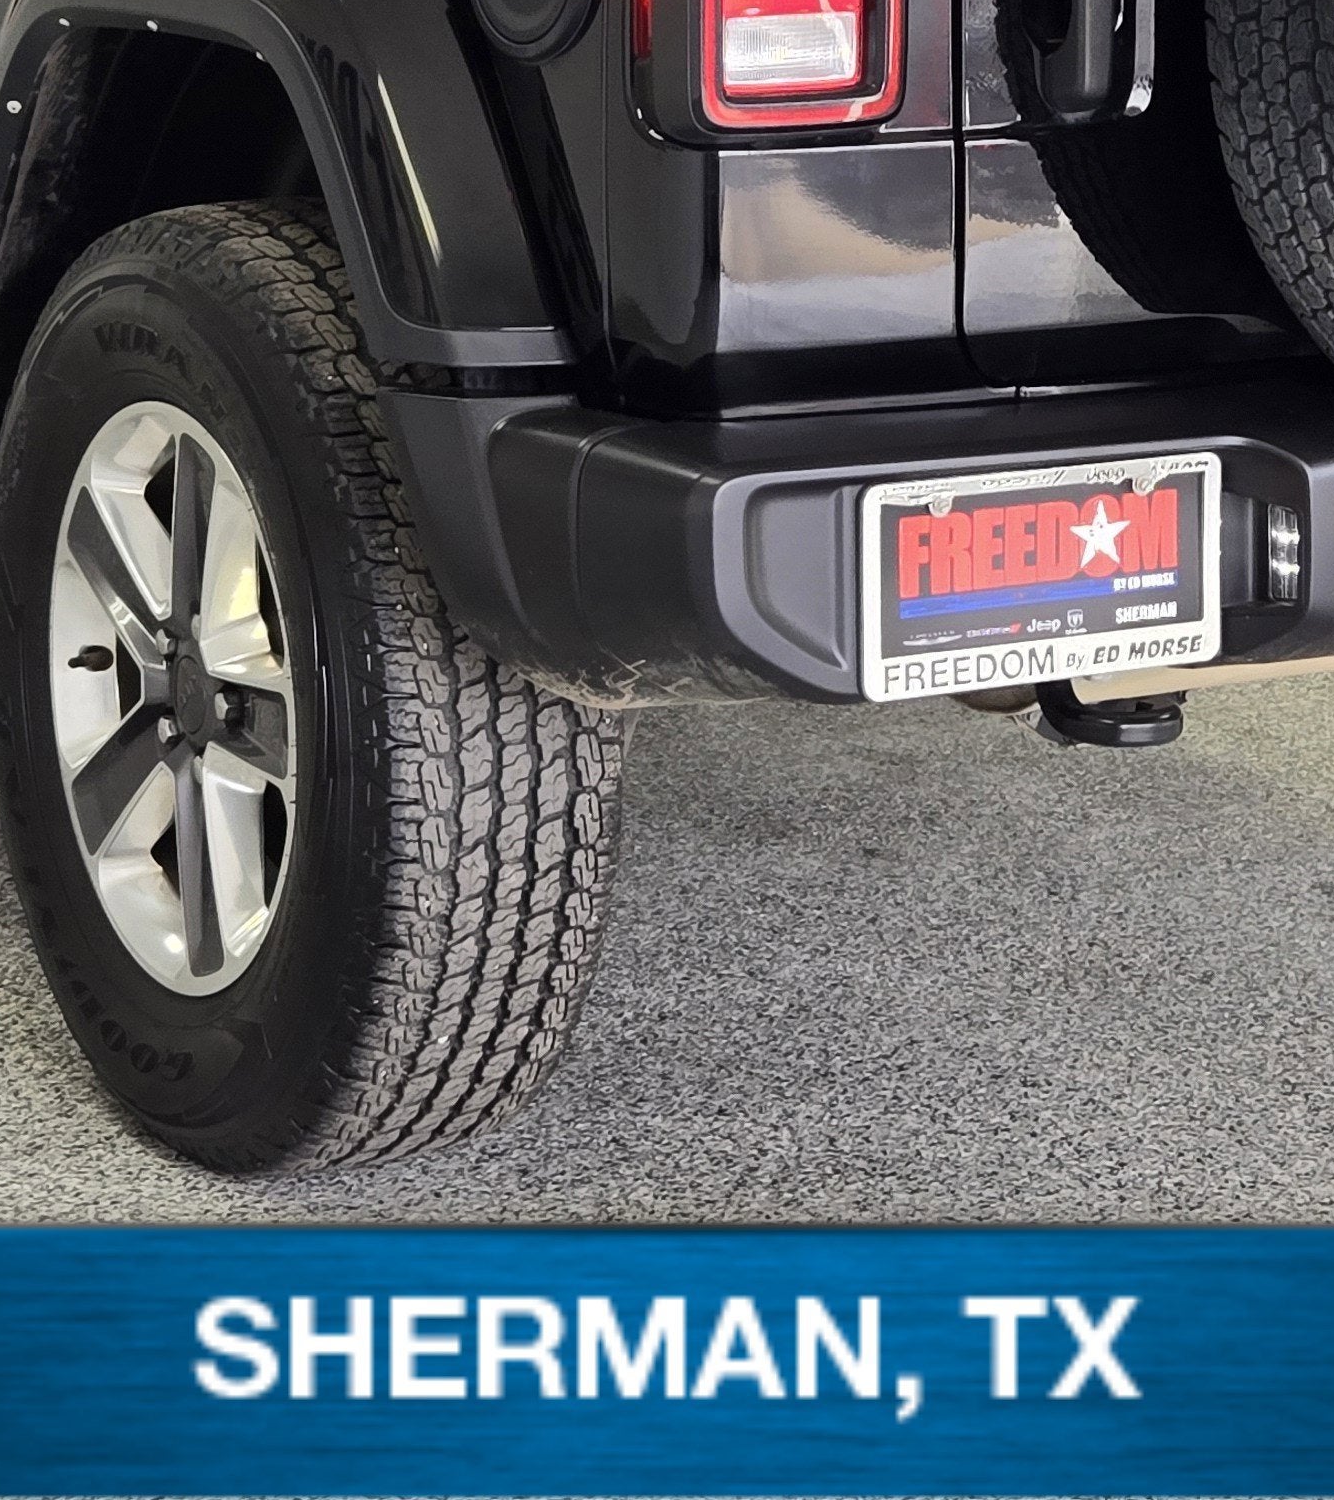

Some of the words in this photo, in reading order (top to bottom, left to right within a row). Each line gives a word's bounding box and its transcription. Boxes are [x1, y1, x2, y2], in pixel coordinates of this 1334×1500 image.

[898, 488, 1179, 599] FREEDOM
[1026, 618, 1062, 633] Jeep
[1115, 601, 1178, 625] SHERMAN
[883, 644, 1056, 695] FREEDOM
[1093, 644, 1121, 666] ED
[1126, 634, 1204, 662] MORSE
